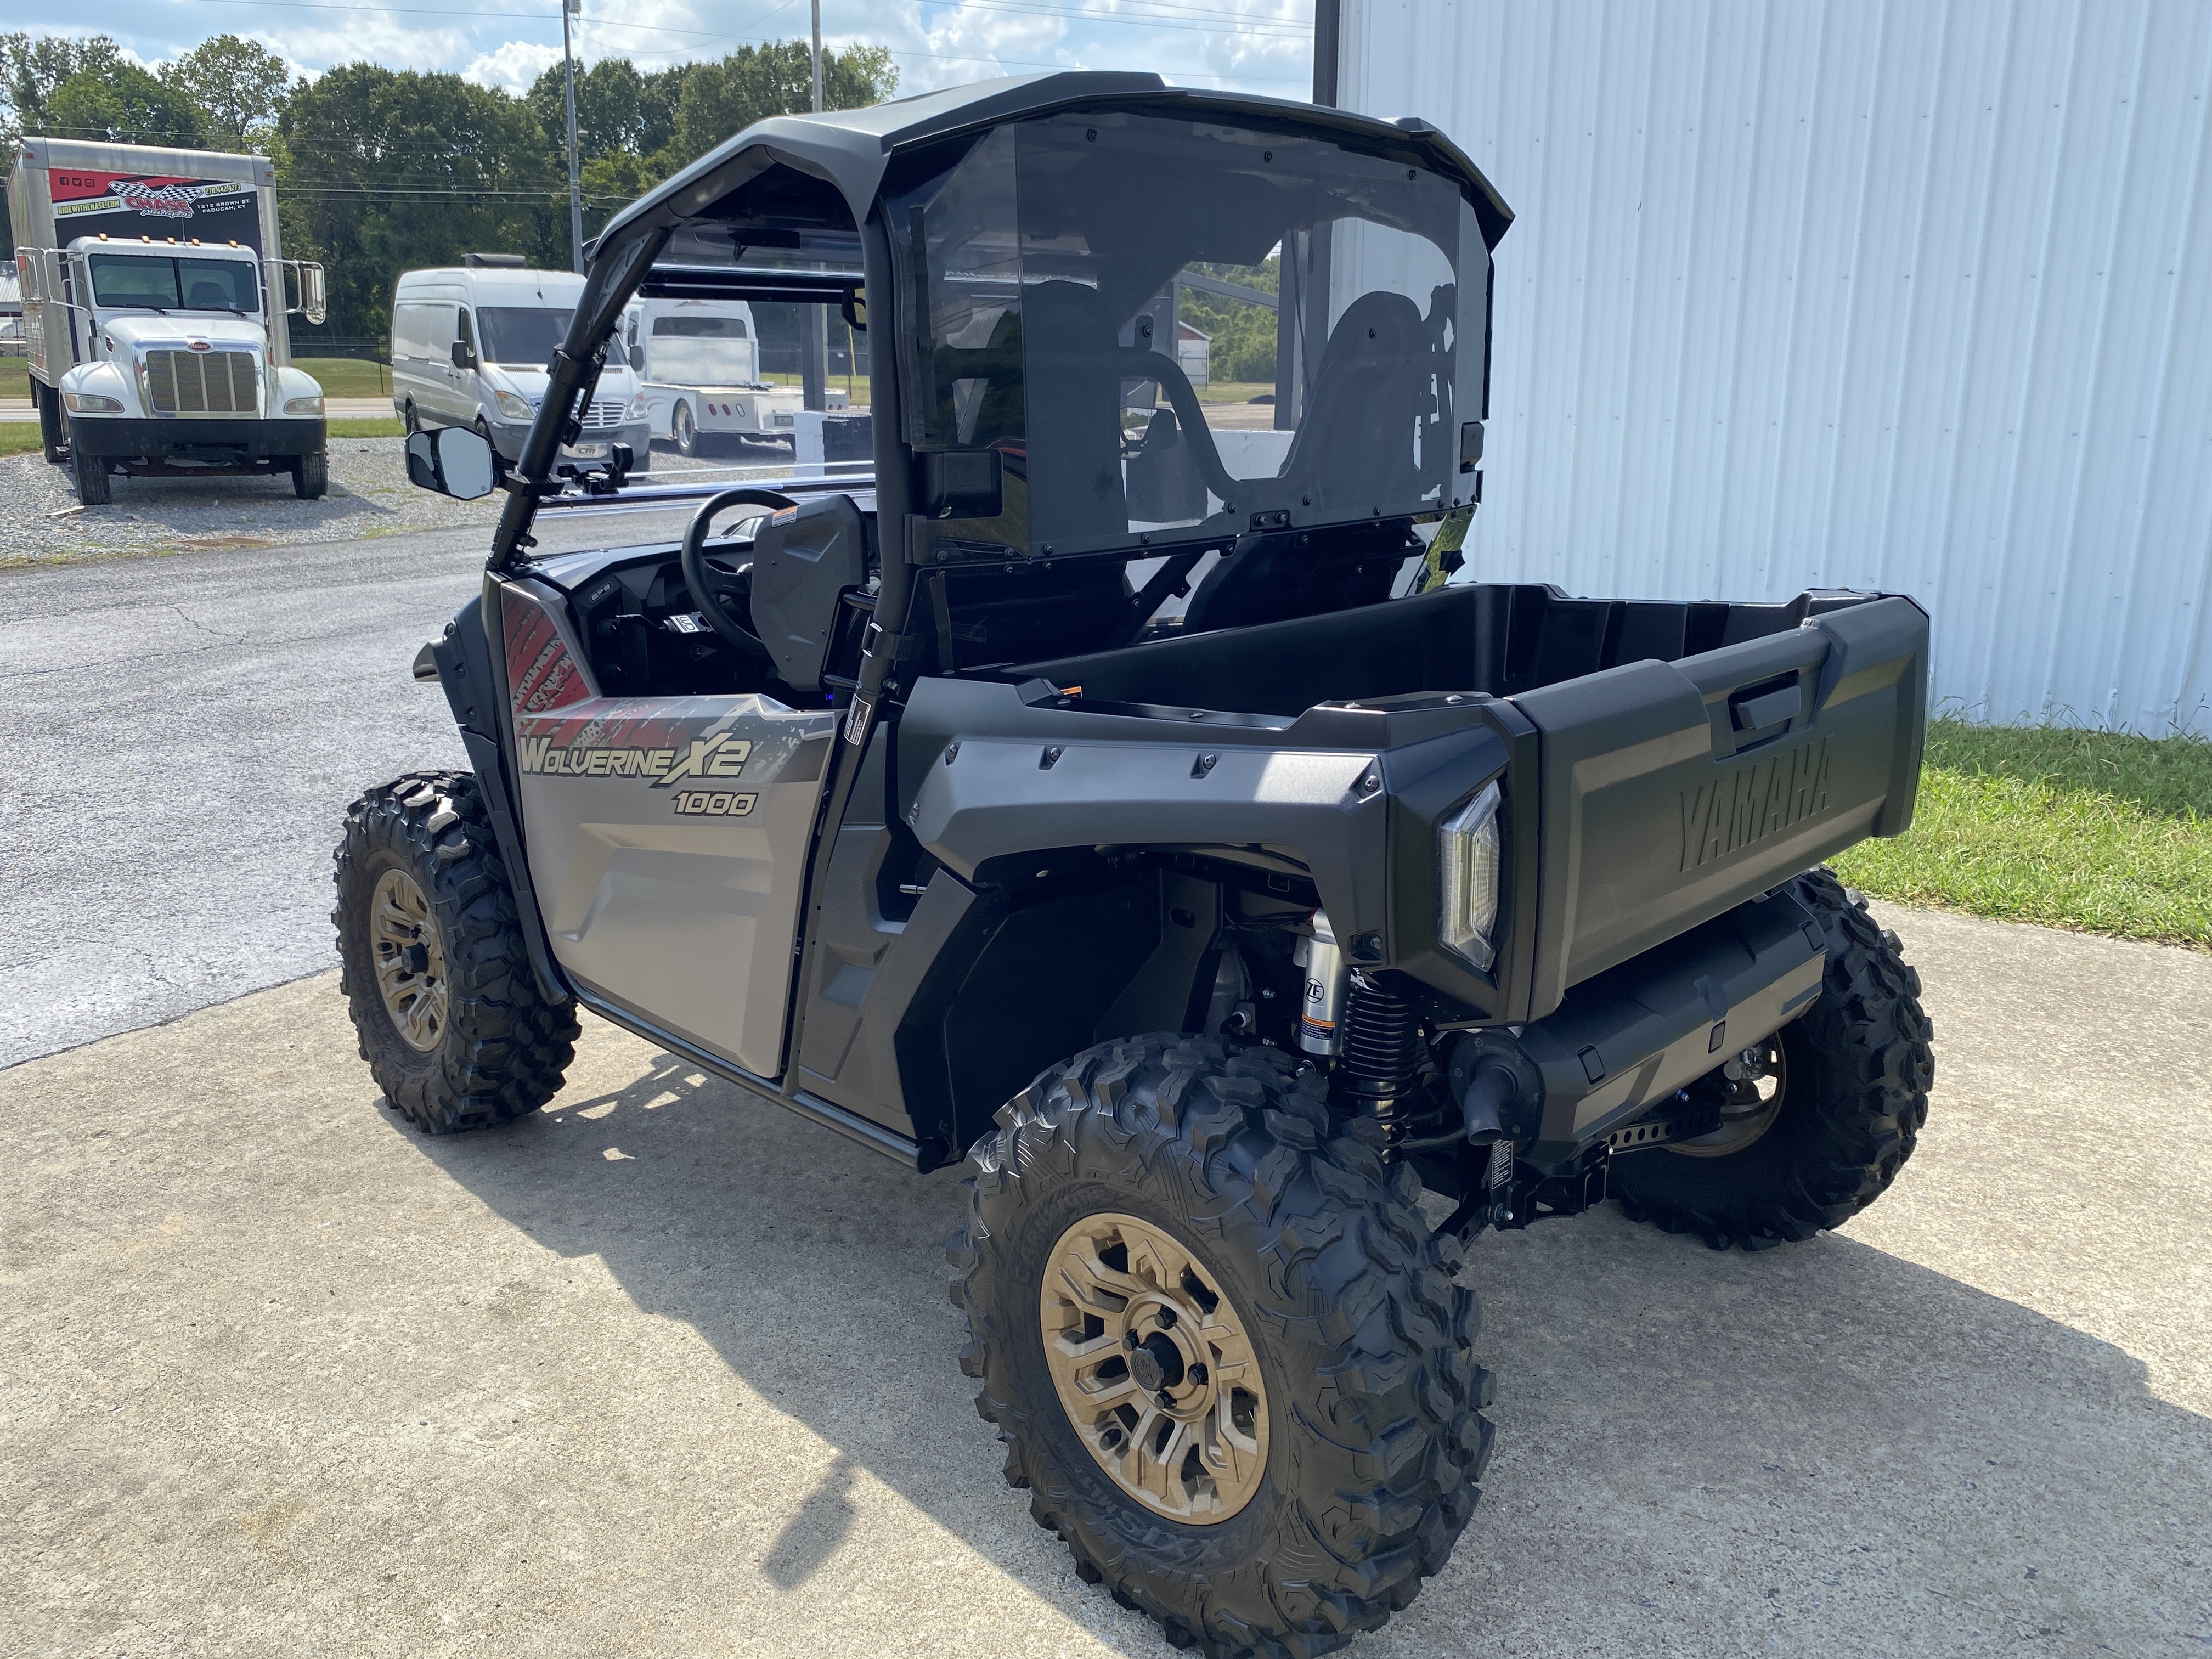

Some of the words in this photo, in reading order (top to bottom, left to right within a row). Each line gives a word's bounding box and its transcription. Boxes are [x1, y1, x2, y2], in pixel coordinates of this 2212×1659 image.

[205, 184, 241, 195] 270.442.4273
[58, 200, 120, 215] RIDEWITHCHASE.COM
[126, 196, 192, 212] CHASE
[141, 209, 192, 218] Motorsports
[658, 732, 752, 784] X2
[676, 792, 757, 816] 1000
[1680, 735, 1835, 872] YAMAHA
[1306, 981, 1323, 1000] ZF
